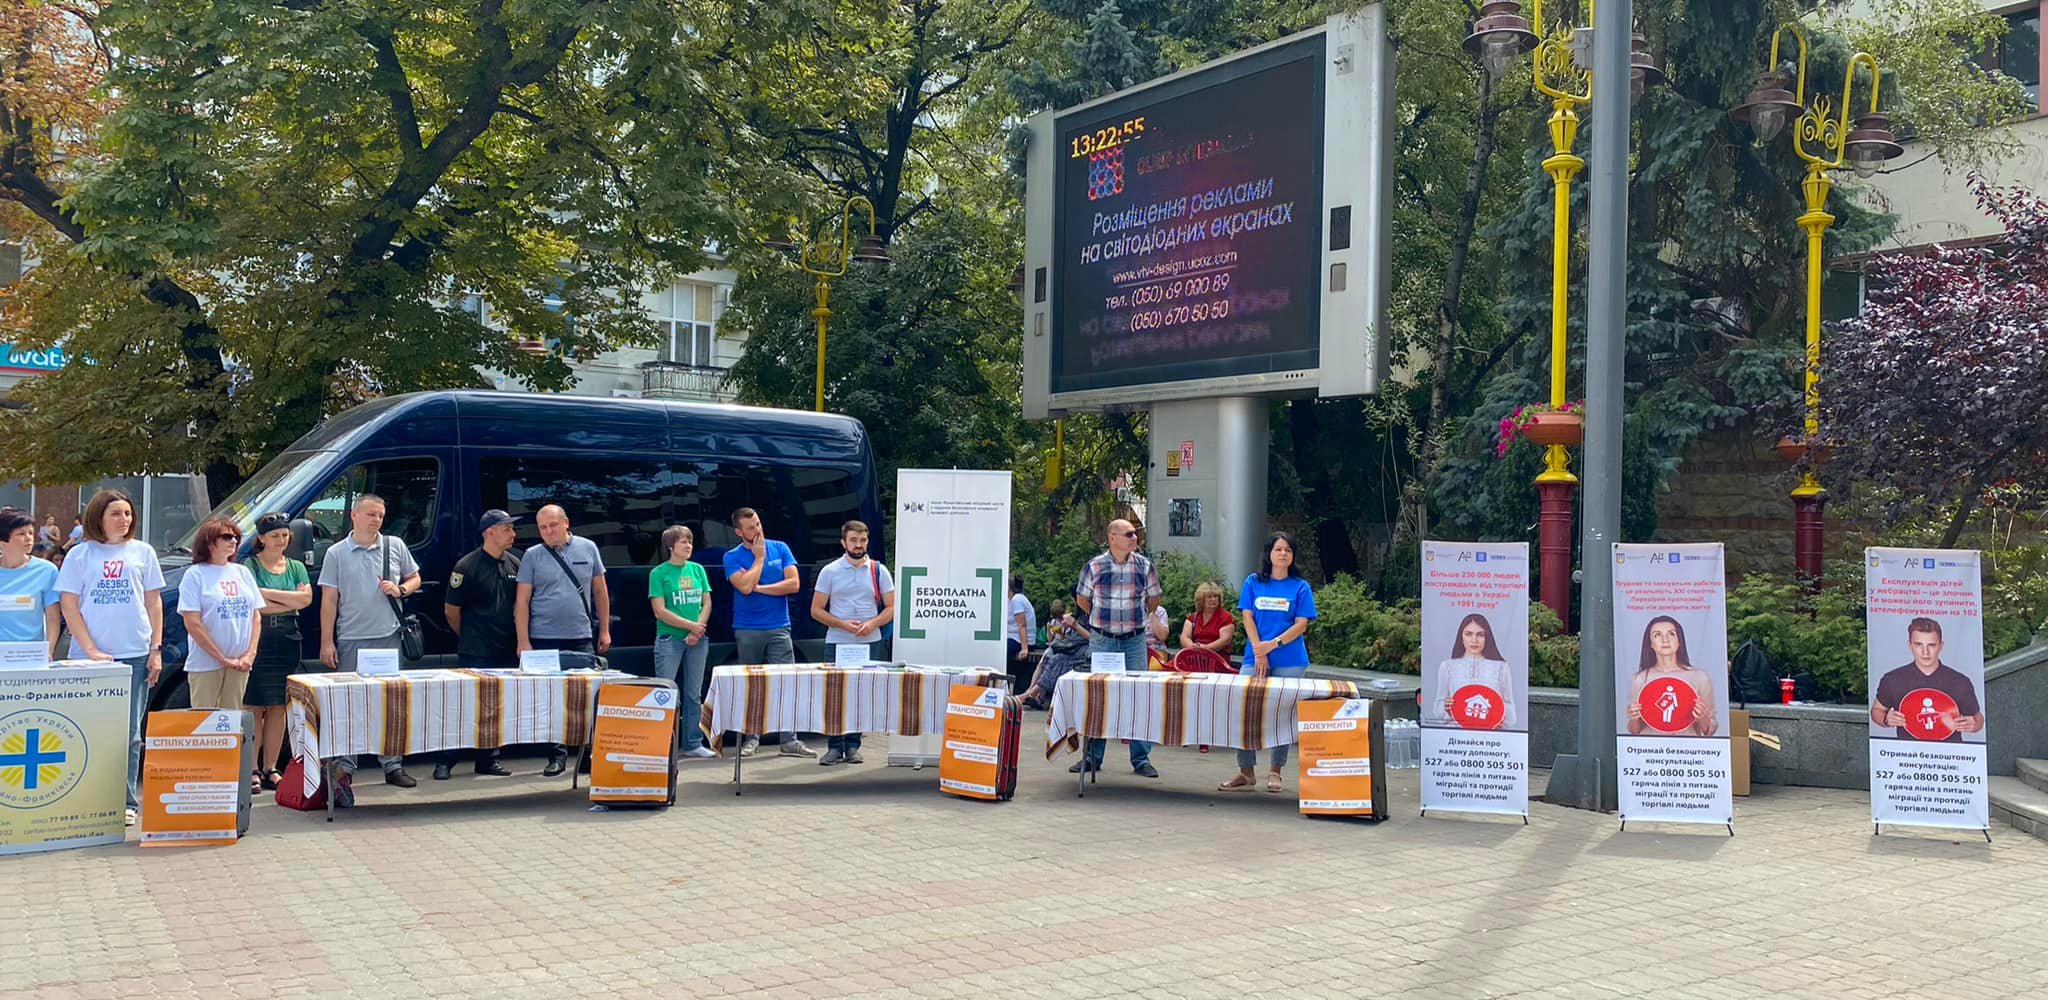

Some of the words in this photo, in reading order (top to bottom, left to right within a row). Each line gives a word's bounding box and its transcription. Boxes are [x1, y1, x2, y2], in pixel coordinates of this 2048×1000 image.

[1071, 117, 1145, 158] 13:22:55
[1092, 196, 1187, 237] Розміщення
[1189, 176, 1273, 220] реклами
[1080, 245, 1101, 264] на
[1210, 202, 1295, 240] екранах
[1105, 293, 1128, 310] тел.
[1131, 285, 1163, 307] (050)
[1165, 281, 1182, 300] 69
[1211, 273, 1230, 292] 89
[1130, 311, 1162, 332] (050)
[1164, 306, 1189, 327] 670
[1191, 302, 1209, 322] 50
[1210, 299, 1230, 319] 50
[103, 560, 124, 578] 527
[916, 587, 987, 598] БЕЗОПЛАТНА
[915, 598, 967, 608] ПРАВОВА
[915, 609, 977, 620] ДОПОМОГА
[603, 707, 652, 718] ДОПОМОГА
[1303, 722, 1353, 730] ДОКУМЕНТИ
[152, 738, 229, 748] СПІЛКУВАННЯ
[1448, 738, 1485, 746] Дізнайся
[1439, 749, 1467, 757] наявну
[1468, 750, 1511, 759] допомогу:
[1627, 746, 1664, 755] Отримай
[1665, 747, 1721, 757] безкоштовну
[1879, 750, 1918, 758] Отримай
[1919, 752, 1977, 762] безкоштовну
[1425, 758, 1442, 766] 527
[1460, 760, 1485, 769] 0800
[1486, 761, 1505, 769] 505
[1507, 762, 1524, 770] 501
[1645, 758, 1705, 767] консультацію:
[1899, 762, 1960, 771] консультацію:
[1432, 771, 1460, 779] гаряча
[1461, 771, 1480, 779] лінія
[1623, 768, 1641, 776] 527
[1643, 769, 1658, 777] або
[1659, 769, 1685, 777] 0800
[1687, 769, 1705, 778] 505
[1708, 770, 1726, 778] 501
[1875, 771, 1894, 779] 527
[1896, 773, 1912, 781] або
[1913, 773, 1939, 782] 0800
[1941, 774, 1960, 783] 505
[1962, 776, 1981, 784] 501
[1435, 781, 1468, 789] міграції
[1479, 783, 1513, 791] протидії
[1631, 781, 1660, 789] гаряча
[1884, 784, 1914, 793] гаряча
[1943, 787, 1974, 795] питань
[1441, 791, 1473, 799] торгівлі
[1474, 793, 1508, 801] людьми
[1635, 790, 1668, 799] міграції
[1679, 791, 1715, 800] протидії
[1888, 794, 1922, 803] міграції
[1934, 796, 1970, 805] протидії
[1641, 800, 1674, 808] торгівлі
[1675, 801, 1710, 810] людьми
[1895, 804, 1928, 812] торгівлі
[1929, 806, 1965, 815] людьми
